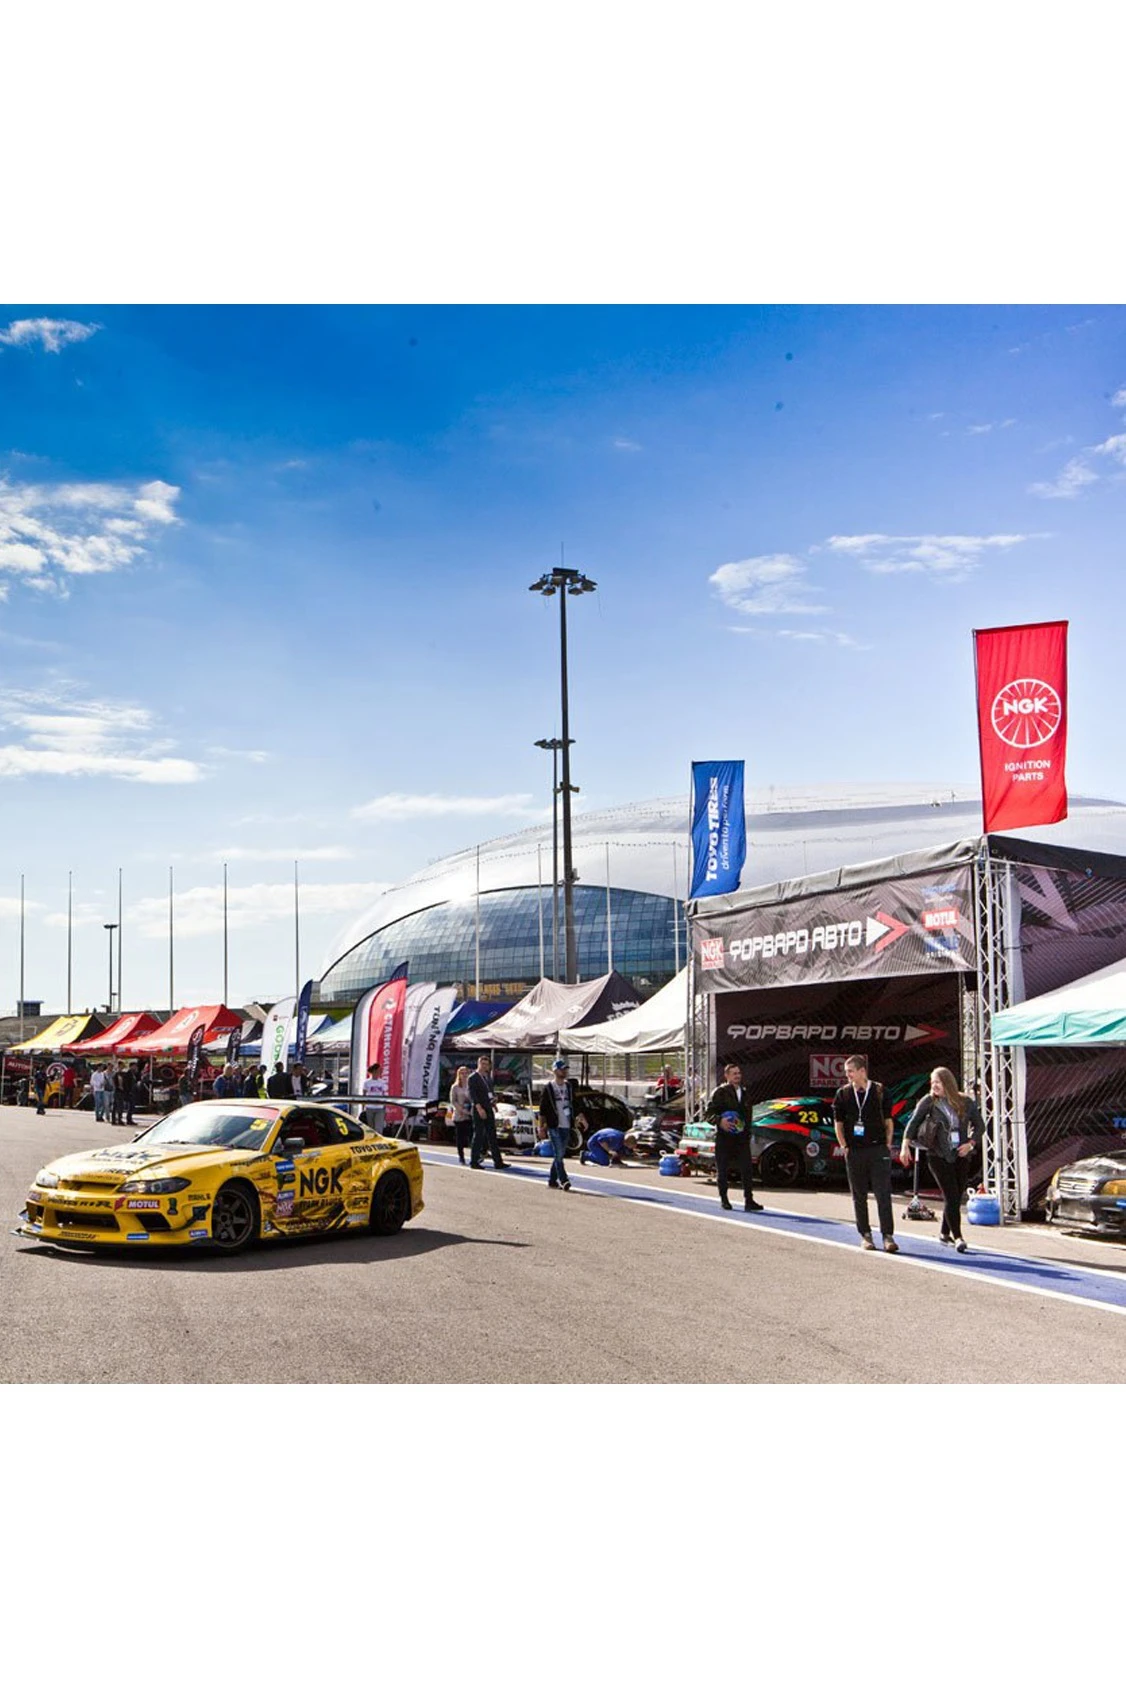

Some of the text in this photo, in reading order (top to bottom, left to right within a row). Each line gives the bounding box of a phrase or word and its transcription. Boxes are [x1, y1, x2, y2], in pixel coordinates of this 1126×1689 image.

[1003, 697, 1048, 716] NGK
[1005, 760, 1050, 772] IGNITION
[1012, 771, 1044, 782] PARTS
[706, 777, 719, 881] TOYO TIRES
[721, 827, 730, 838] to
[720, 838, 730, 870] driven
[925, 911, 957, 928] MOTUL
[811, 920, 862, 951] АВТО
[701, 940, 723, 961] NGK
[841, 1025, 901, 1040] АВТО
[811, 1056, 846, 1078] NG
[250, 1119, 268, 1130] 5
[798, 1111, 819, 1123] 23
[335, 1117, 349, 1135] 5
[350, 1144, 372, 1154] TOYO
[300, 1167, 344, 1197] NGK
[128, 1200, 159, 1208] MOTUL
